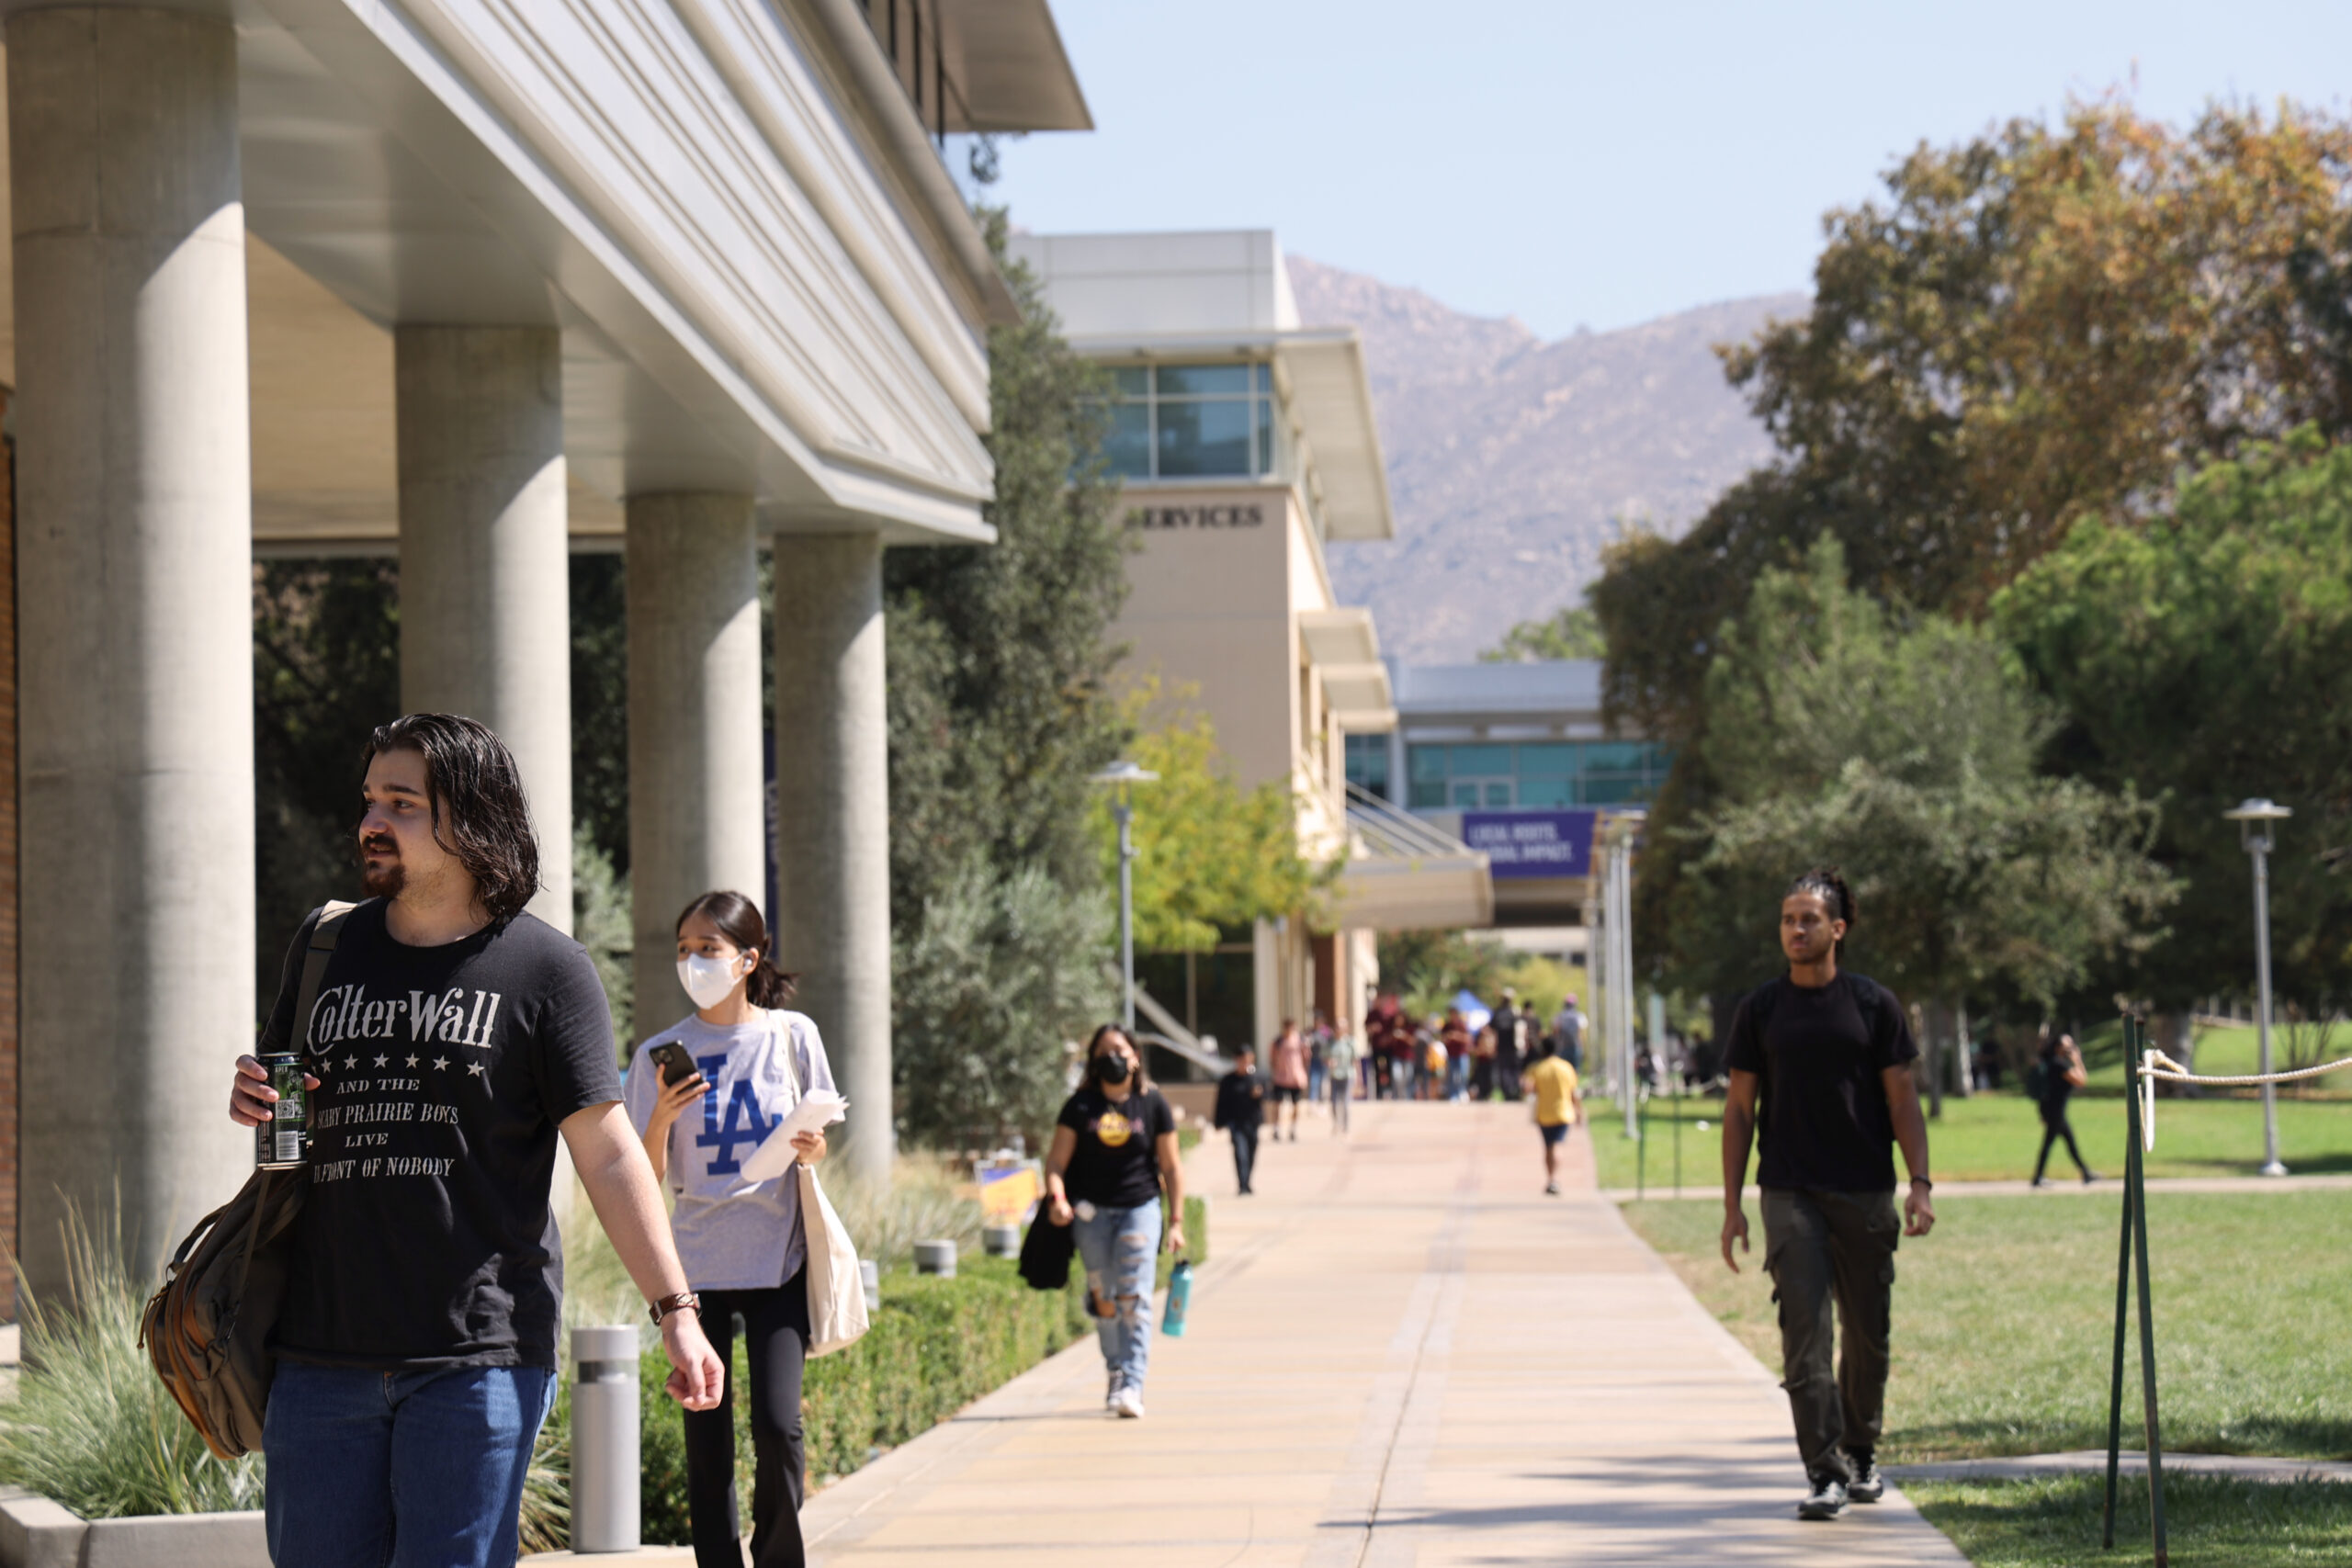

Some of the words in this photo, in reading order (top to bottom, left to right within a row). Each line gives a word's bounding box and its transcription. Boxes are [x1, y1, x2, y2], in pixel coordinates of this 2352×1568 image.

[1125, 504, 1262, 529] ERVICES
[306, 984, 407, 1055] Colter
[408, 987, 501, 1048] Wall
[336, 1079, 369, 1094] AND
[377, 1078, 420, 1091] THE
[317, 1107, 342, 1129] SCARY
[345, 1102, 414, 1124] PRAIRIE
[419, 1103, 458, 1124] BOYS
[695, 1054, 784, 1176] LA
[345, 1133, 389, 1147] LIVE
[321, 1159, 356, 1182] FRONT
[362, 1157, 381, 1178] OF
[386, 1156, 455, 1177] NOBODY
